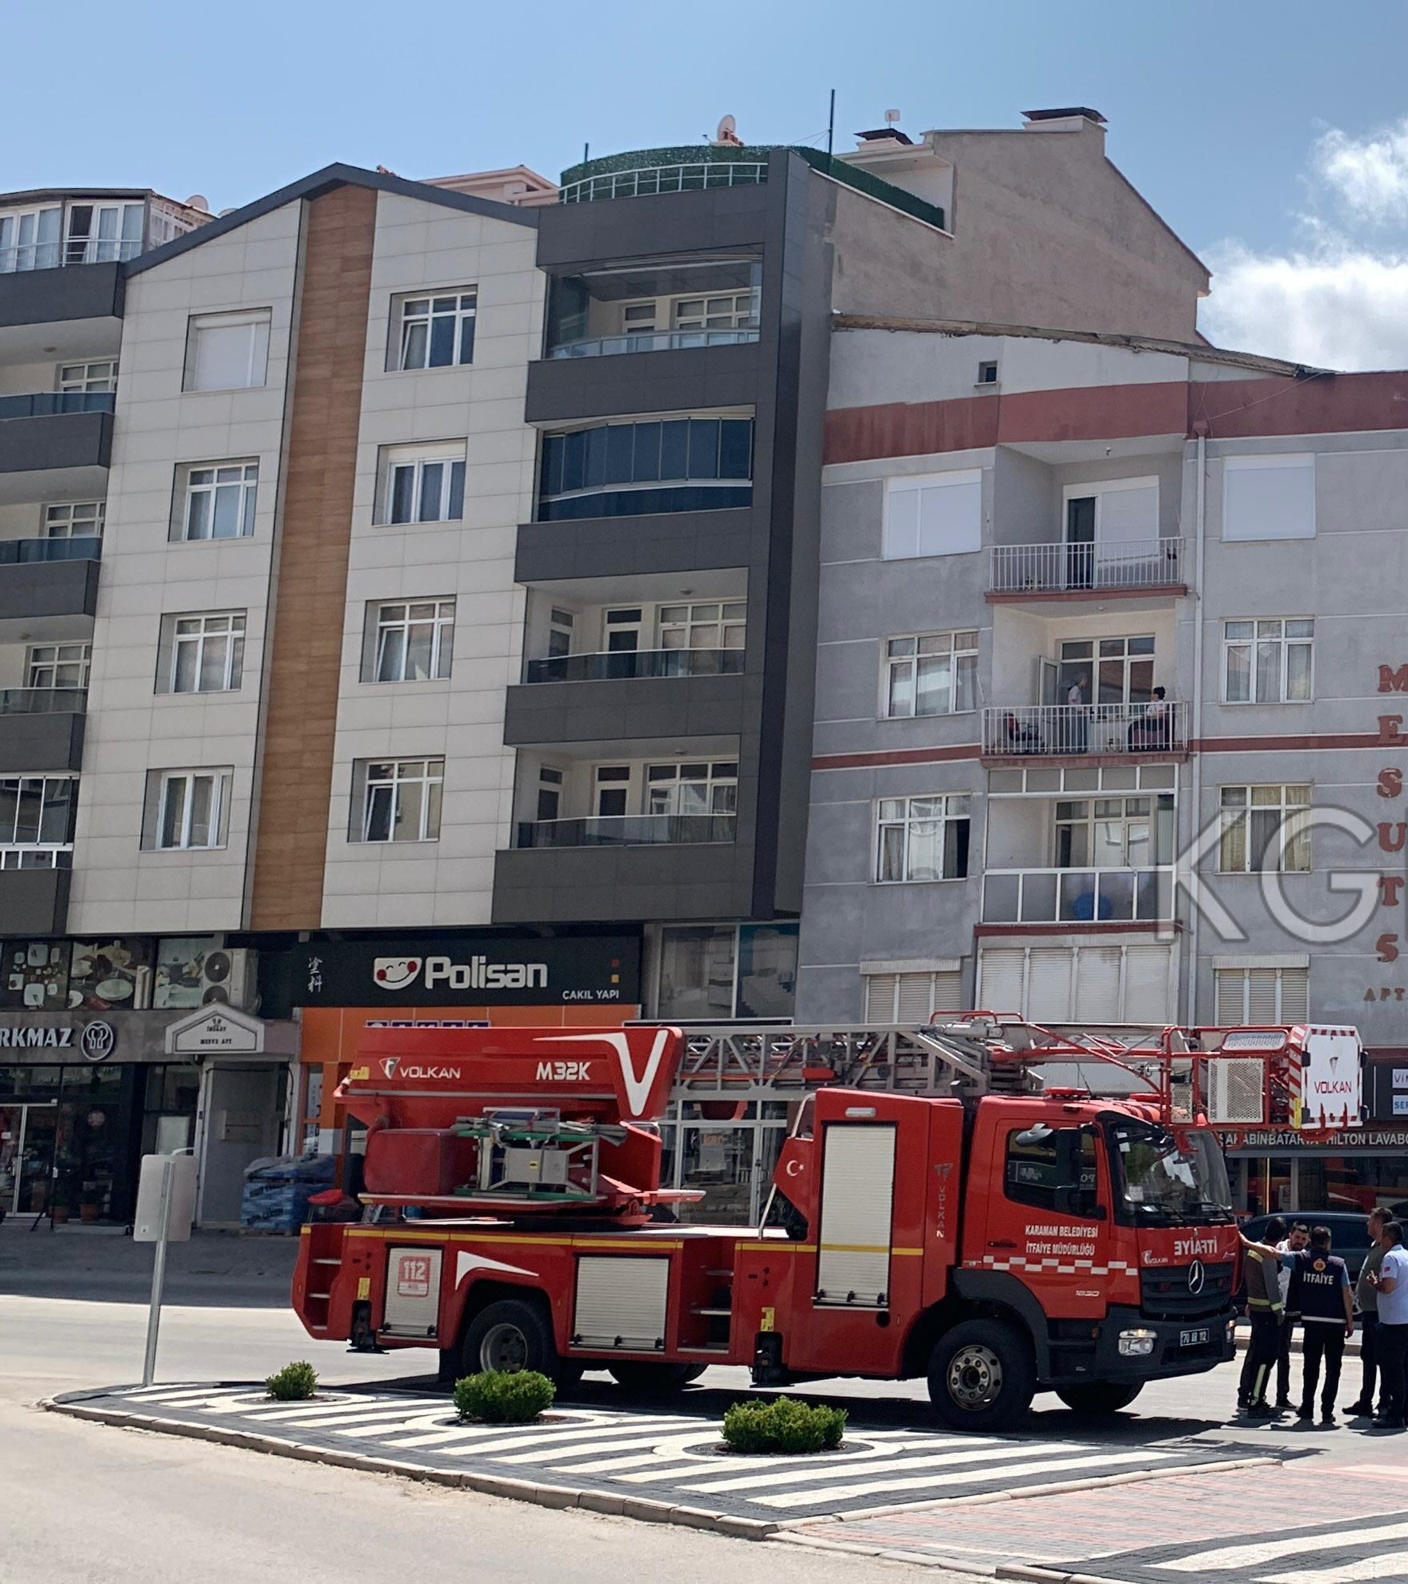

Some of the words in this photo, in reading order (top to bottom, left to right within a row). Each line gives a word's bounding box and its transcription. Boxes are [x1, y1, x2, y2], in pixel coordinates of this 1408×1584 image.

[425, 956, 548, 989] Polisan
[596, 990, 619, 1000] YAPI
[400, 1066, 461, 1079] VOLKAN
[535, 1061, 592, 1081] M32K
[1314, 1081, 1352, 1094] VOLKAN
[936, 1185, 946, 1238] VOLKAN
[1024, 1224, 1058, 1237] KARAMAN
[1059, 1224, 1098, 1237] BELEDİYESİ
[1025, 1241, 1051, 1254] İTFAİYE
[1052, 1241, 1095, 1256] MÜDÜRLÜĞÜ
[403, 1260, 425, 1280] 112
[1303, 1270, 1334, 1285] İTFAİYE
